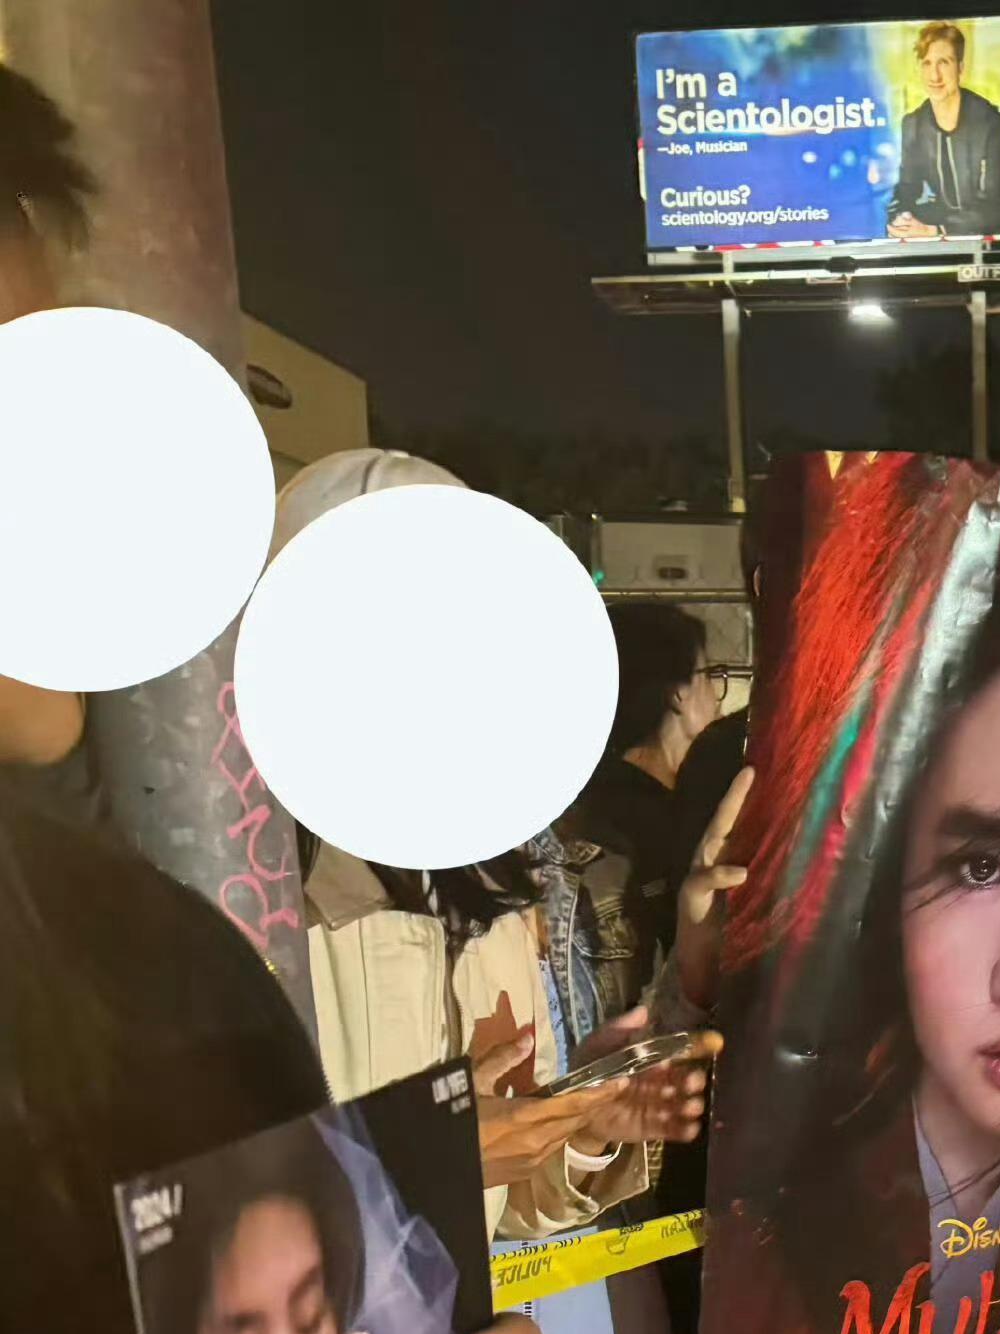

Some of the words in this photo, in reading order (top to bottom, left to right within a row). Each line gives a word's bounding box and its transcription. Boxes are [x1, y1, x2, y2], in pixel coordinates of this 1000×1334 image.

[656, 68, 707, 99] I’m
[717, 71, 738, 97] a
[656, 96, 887, 136] Scientologist.
[695, 139, 749, 154] Musician
[660, 184, 752, 208] Curious?
[661, 206, 830, 227] scientology.org/stories
